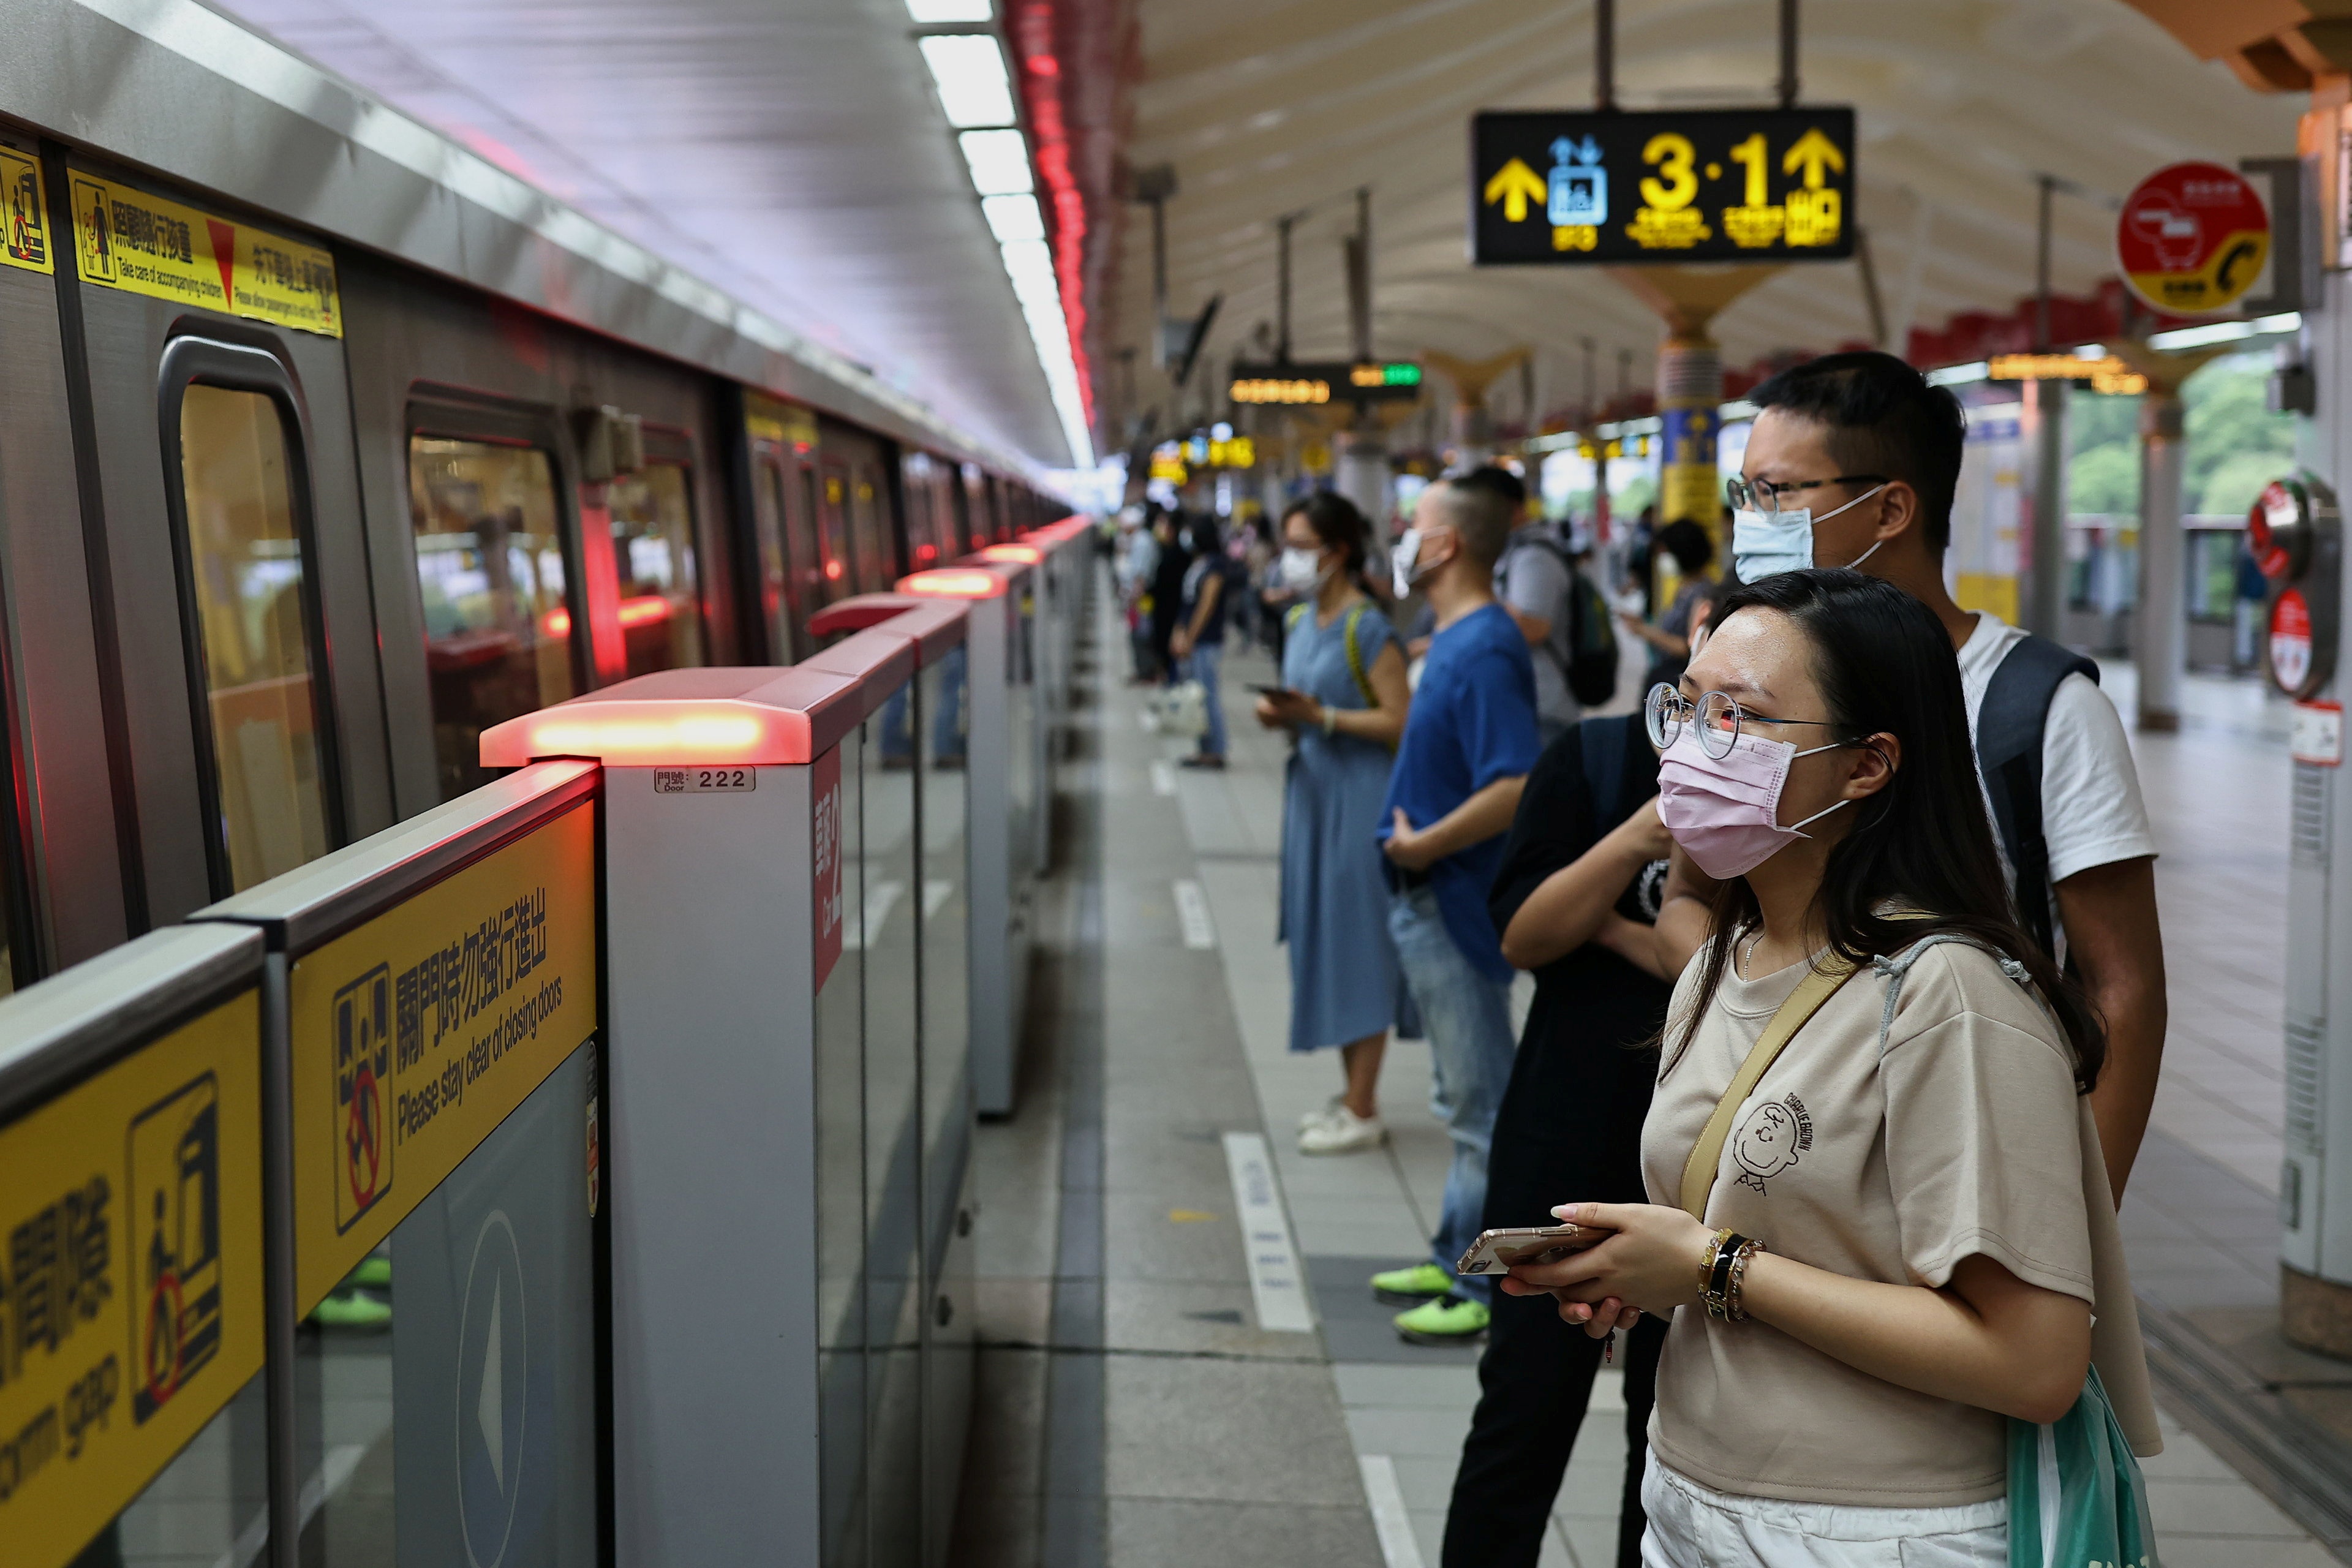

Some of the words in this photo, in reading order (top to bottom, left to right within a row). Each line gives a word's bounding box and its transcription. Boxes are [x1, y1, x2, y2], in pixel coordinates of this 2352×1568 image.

[117, 256, 134, 277] Take
[135, 265, 149, 282] care
[149, 264, 156, 283] of
[699, 771, 745, 788] 222
[396, 886, 546, 1076] 關門時勿強行進出
[398, 1079, 439, 1147] Please
[441, 1057, 464, 1107] stay
[466, 1034, 491, 1085] clear
[492, 1014, 503, 1063] of
[504, 995, 537, 1052] closing
[538, 976, 562, 1022] doors
[1784, 1092, 1810, 1124] CHARLIE
[1797, 1123, 1813, 1152] BROWN
